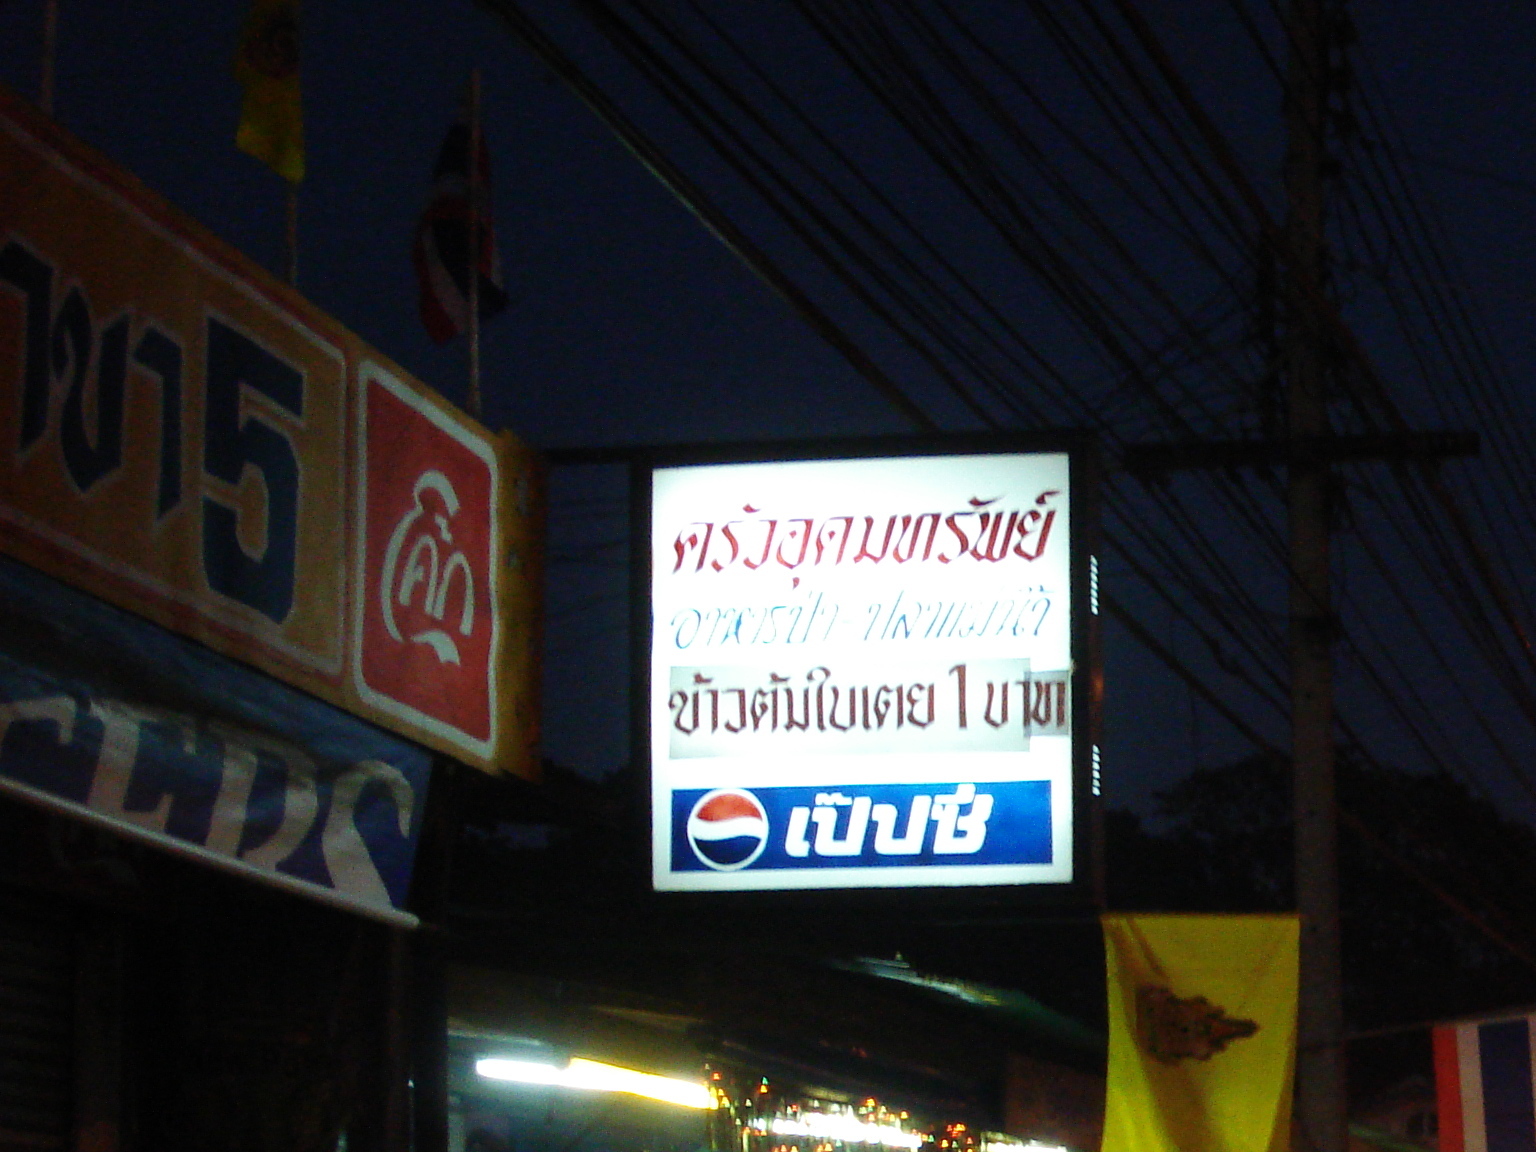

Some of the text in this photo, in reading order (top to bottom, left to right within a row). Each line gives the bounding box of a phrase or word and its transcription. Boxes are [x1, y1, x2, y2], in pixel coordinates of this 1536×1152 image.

[671, 489, 1061, 590] ครัวอุดมทรัพย์
[668, 665, 936, 736] ข้าวต้มใบเตย
[784, 783, 994, 858] เป๊ปซี่
